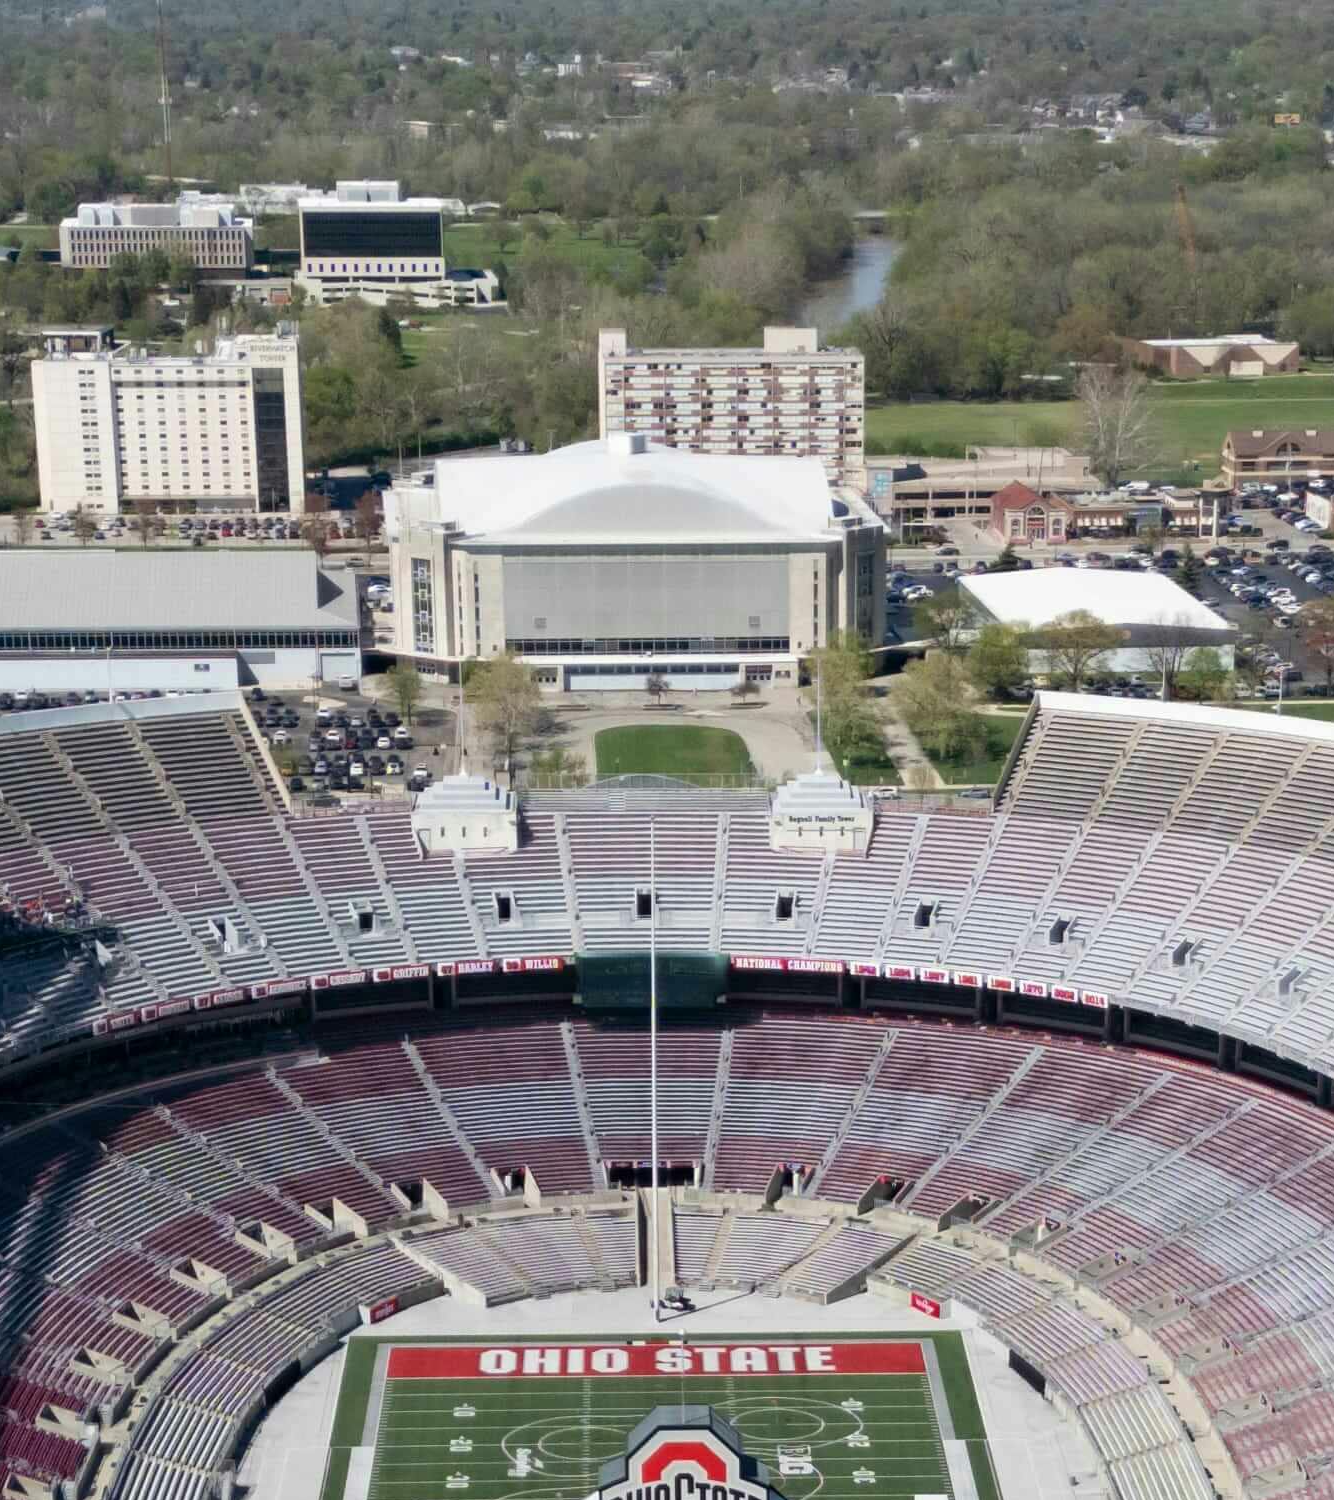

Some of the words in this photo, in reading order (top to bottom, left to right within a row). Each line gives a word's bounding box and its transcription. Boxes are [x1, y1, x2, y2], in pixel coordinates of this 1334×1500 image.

[815, 815, 836, 825] Family
[837, 815, 855, 823] Tower
[525, 958, 559, 970] WILLIS
[735, 957, 783, 969] NATIONAL
[787, 959, 843, 972] CHAMPIONS
[393, 966, 430, 978] GRIFFIN
[478, 1348, 630, 1374] OHIO
[654, 1346, 837, 1373] STATE
